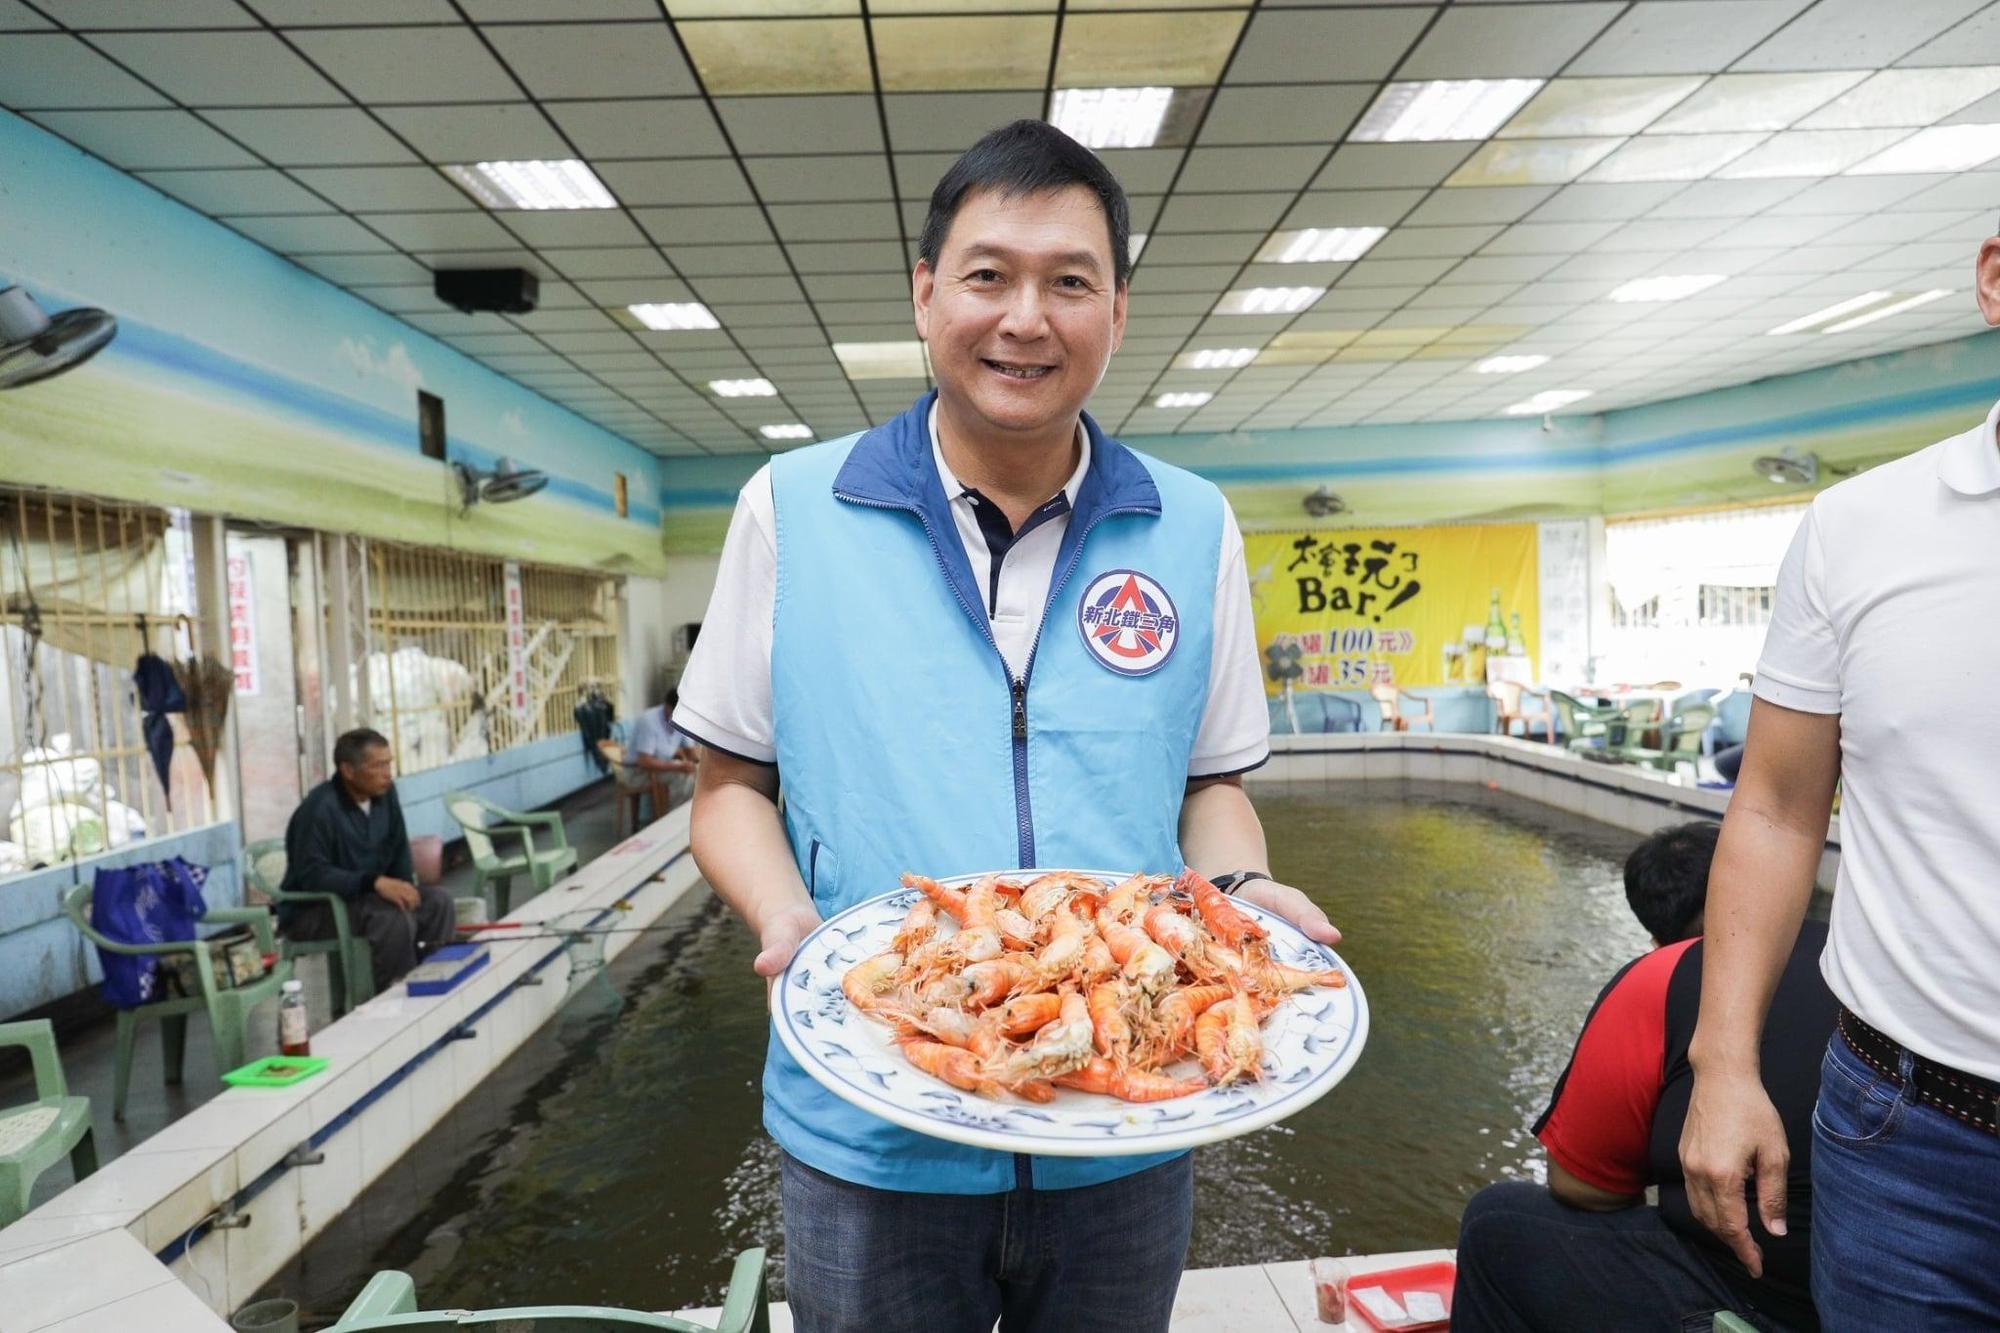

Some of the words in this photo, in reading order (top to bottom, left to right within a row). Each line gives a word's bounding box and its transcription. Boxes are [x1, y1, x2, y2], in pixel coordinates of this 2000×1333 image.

[1083, 605, 1175, 634] 新北鐵三角
